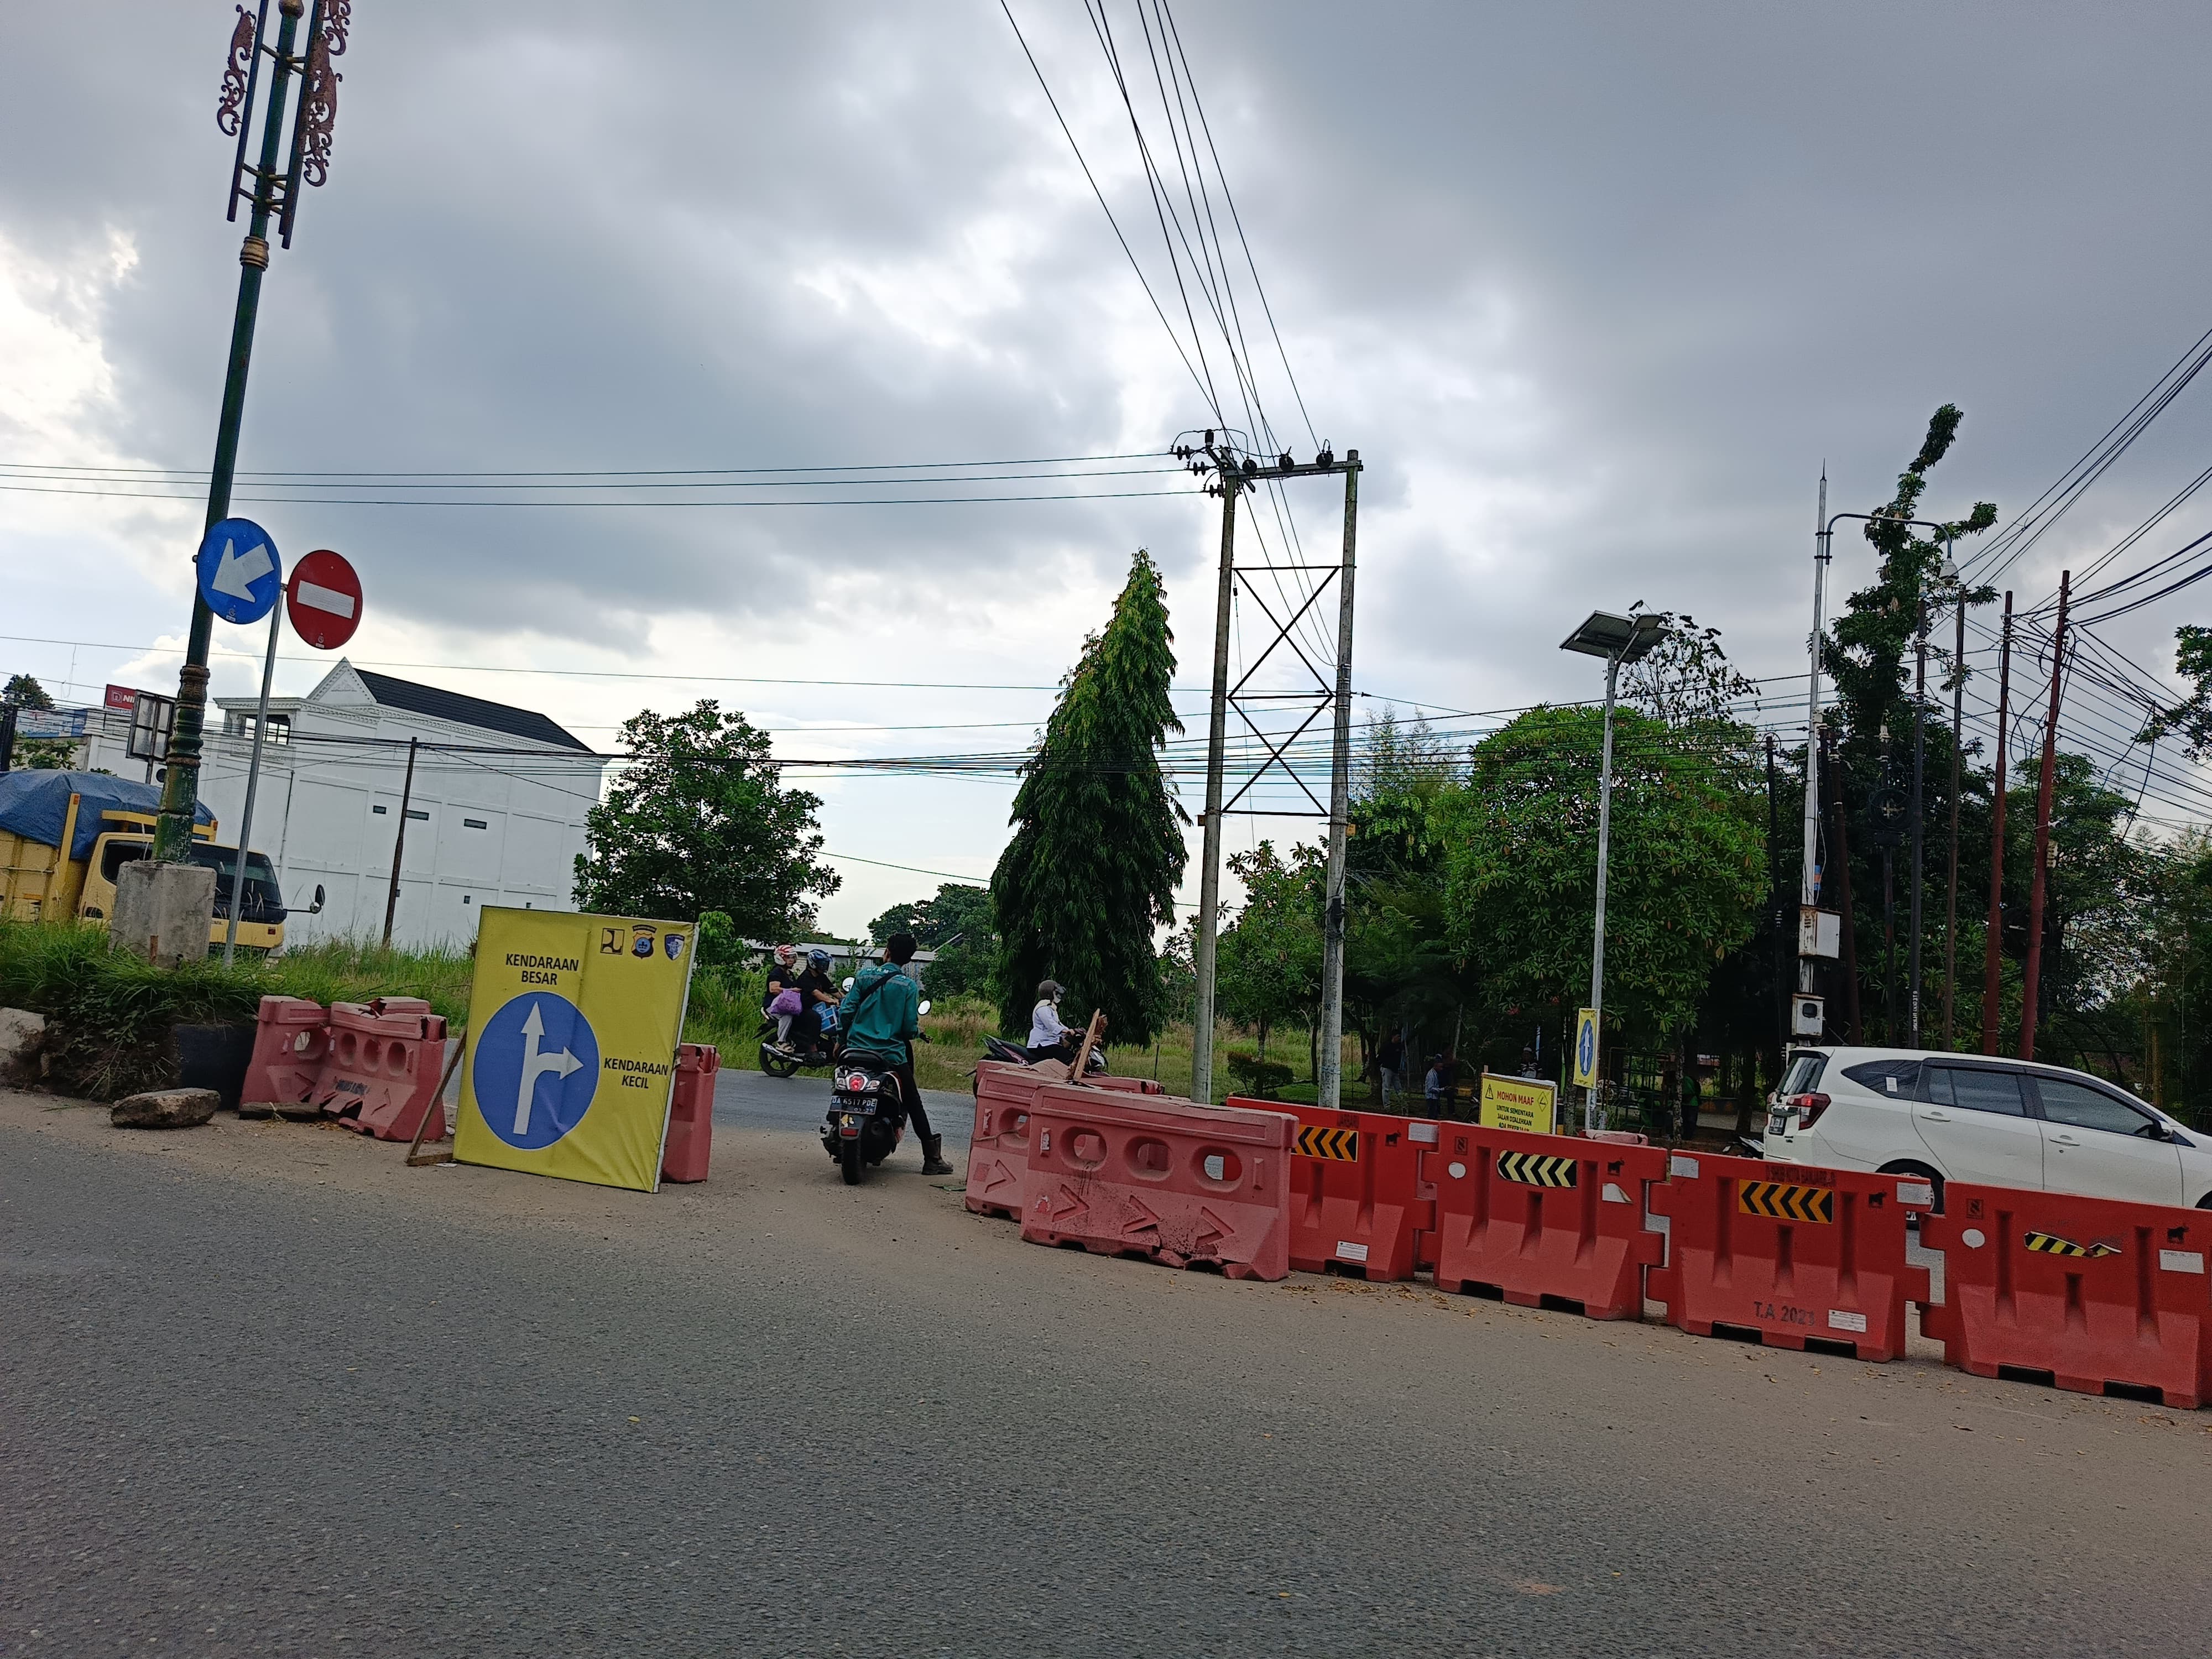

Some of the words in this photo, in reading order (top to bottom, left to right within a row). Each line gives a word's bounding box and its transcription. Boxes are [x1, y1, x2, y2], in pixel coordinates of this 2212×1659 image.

[505, 953, 579, 972] KENDARAAN
[521, 971, 557, 985] BESAR
[604, 1057, 669, 1076] KENDARAAN
[622, 1074, 649, 1089] KECIL
[1496, 1091, 1517, 1103] MOHON
[1518, 1094, 1534, 1106] MAAF
[1496, 1104, 1510, 1113] UNTUK
[1510, 1107, 1534, 1118] SEMENTARA
